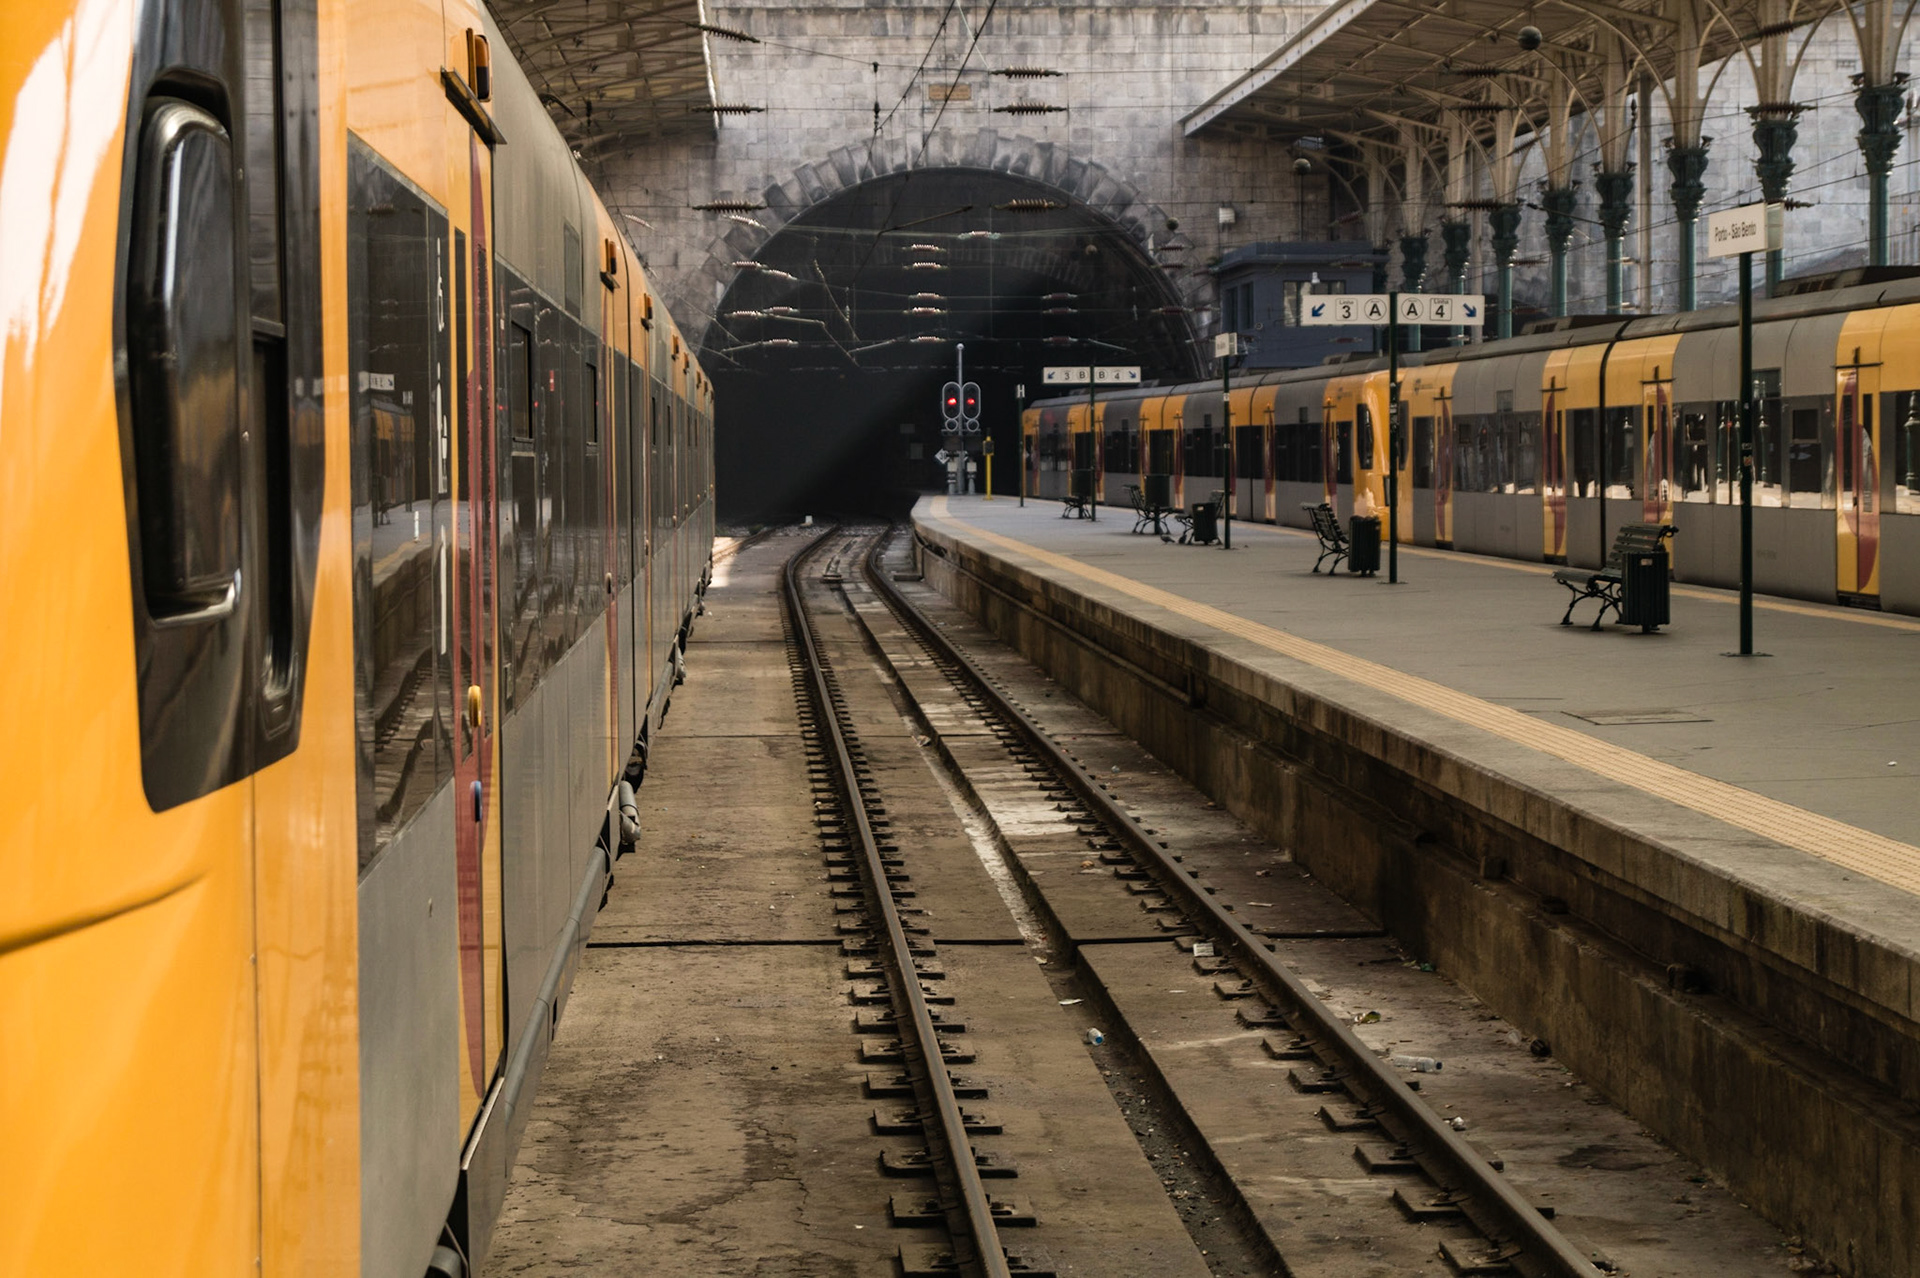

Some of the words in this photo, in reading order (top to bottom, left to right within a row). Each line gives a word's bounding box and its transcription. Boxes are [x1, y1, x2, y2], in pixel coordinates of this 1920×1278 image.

[1714, 226, 1727, 242] Porto
[1731, 223, 1740, 239] São
[1741, 221, 1757, 237] Bento
[1342, 305, 1351, 319] 3
[1369, 303, 1381, 316] A
[1406, 302, 1418, 316] A
[1435, 304, 1445, 318] 4
[1064, 372, 1070, 380] 3
[1079, 371, 1086, 379] B
[1098, 371, 1105, 379] B
[1114, 372, 1120, 380] 4
[1016, 384, 1025, 398] H
